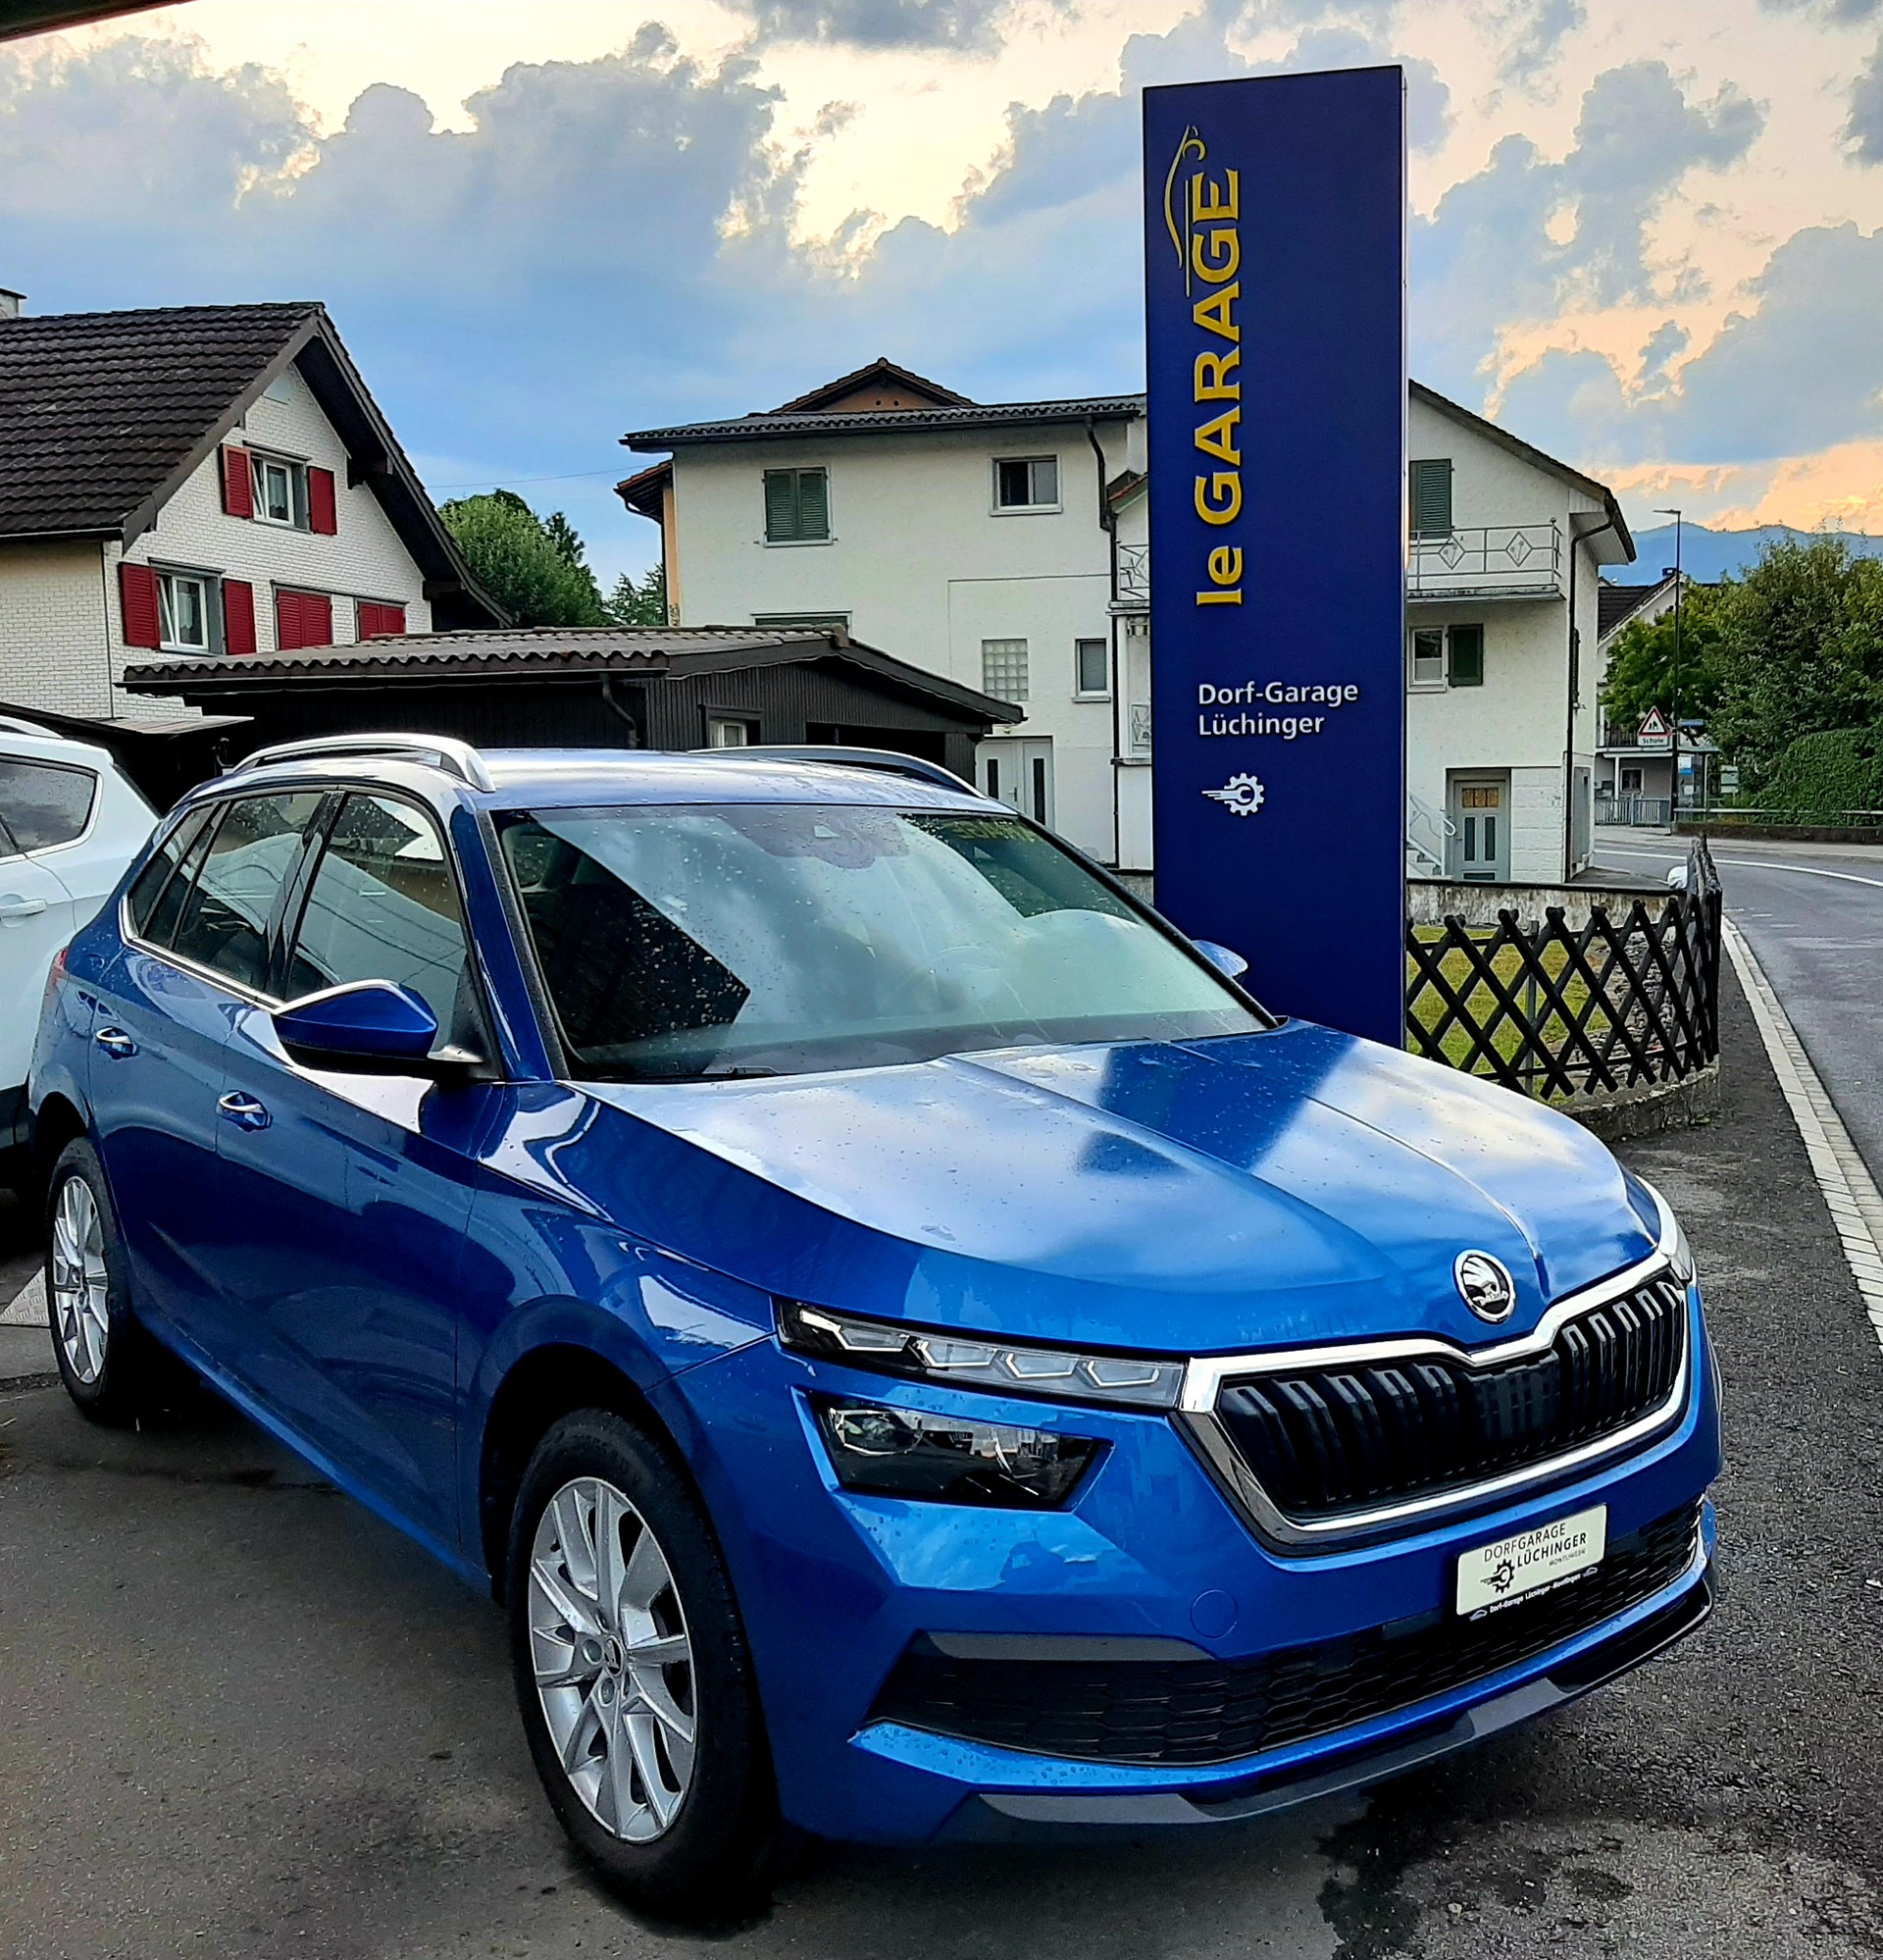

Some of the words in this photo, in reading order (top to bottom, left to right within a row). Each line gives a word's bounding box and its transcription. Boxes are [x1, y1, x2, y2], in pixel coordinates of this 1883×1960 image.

[1193, 168, 1242, 526] GARAGE
[1196, 545, 1243, 605] le
[1198, 681, 1358, 707] Dorf-Garage
[1198, 712, 1325, 740] Lüchinger
[1484, 1522, 1566, 1563] DORFGARAGE
[1517, 1532, 1587, 1568] LÜCHINGER
